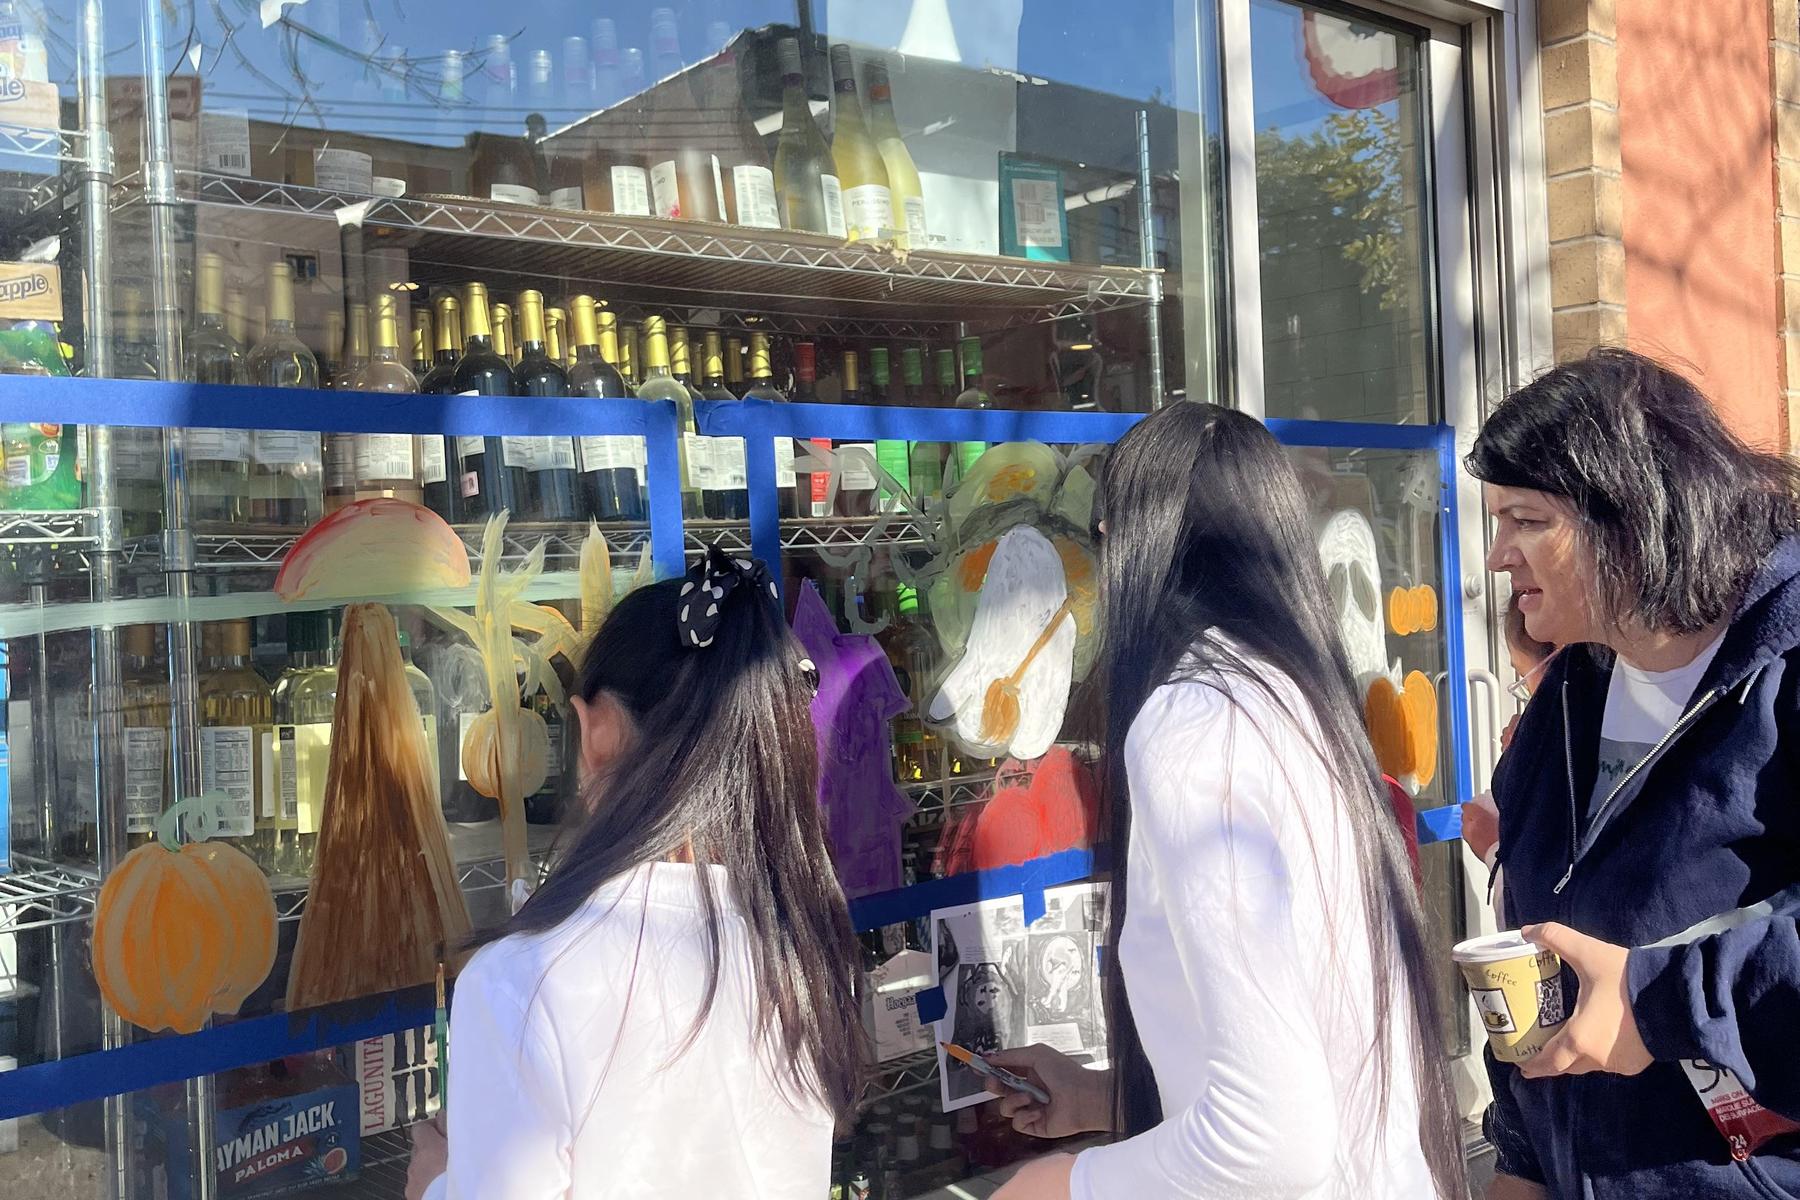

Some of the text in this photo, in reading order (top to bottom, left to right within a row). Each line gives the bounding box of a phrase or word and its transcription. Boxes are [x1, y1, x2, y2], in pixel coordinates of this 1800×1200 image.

[0, 77, 21, 96] le
[1486, 968, 1518, 987] Coffee
[283, 1101, 336, 1143] JACK
[1729, 1134, 1748, 1149] 24
[235, 1146, 304, 1184] PALOMA
